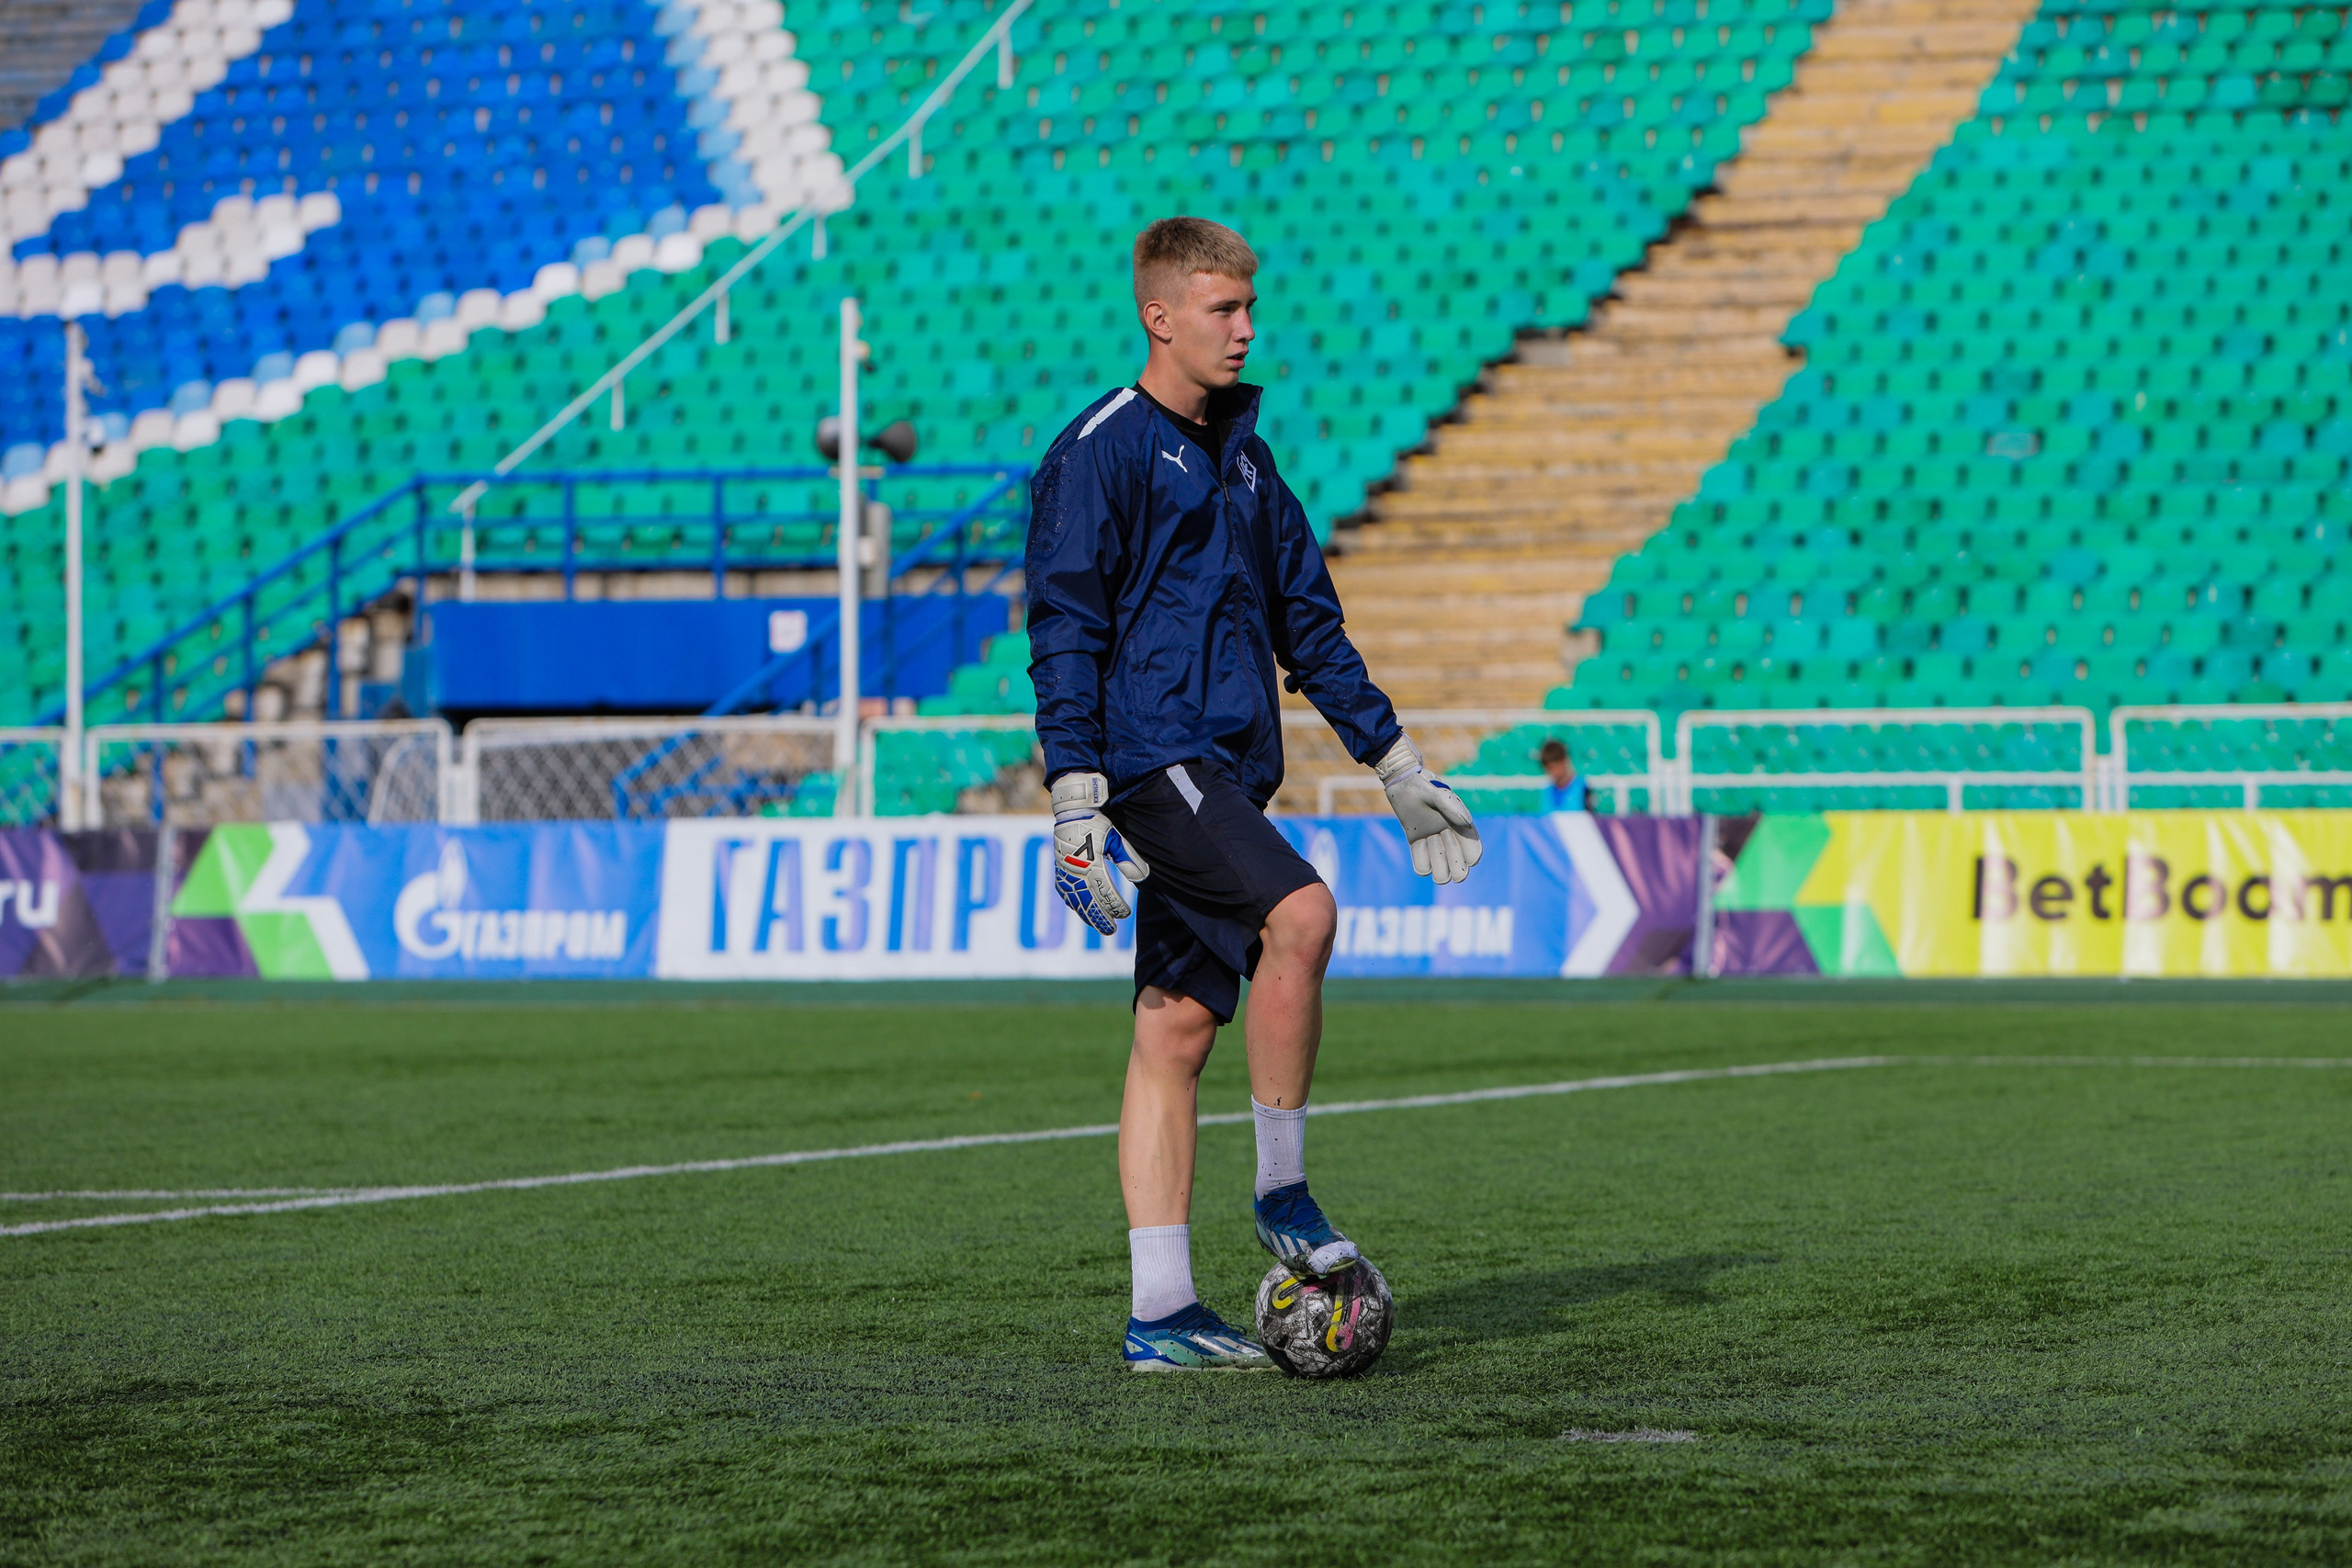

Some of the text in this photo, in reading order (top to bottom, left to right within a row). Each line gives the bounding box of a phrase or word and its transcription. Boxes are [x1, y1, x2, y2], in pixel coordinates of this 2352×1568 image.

[1094, 878, 1120, 917] ALPHA
[1972, 855, 2352, 921] BetBoom
[460, 909, 628, 960] ГАЗПРОМ
[1336, 905, 1514, 957] ГАЗПРОМ
